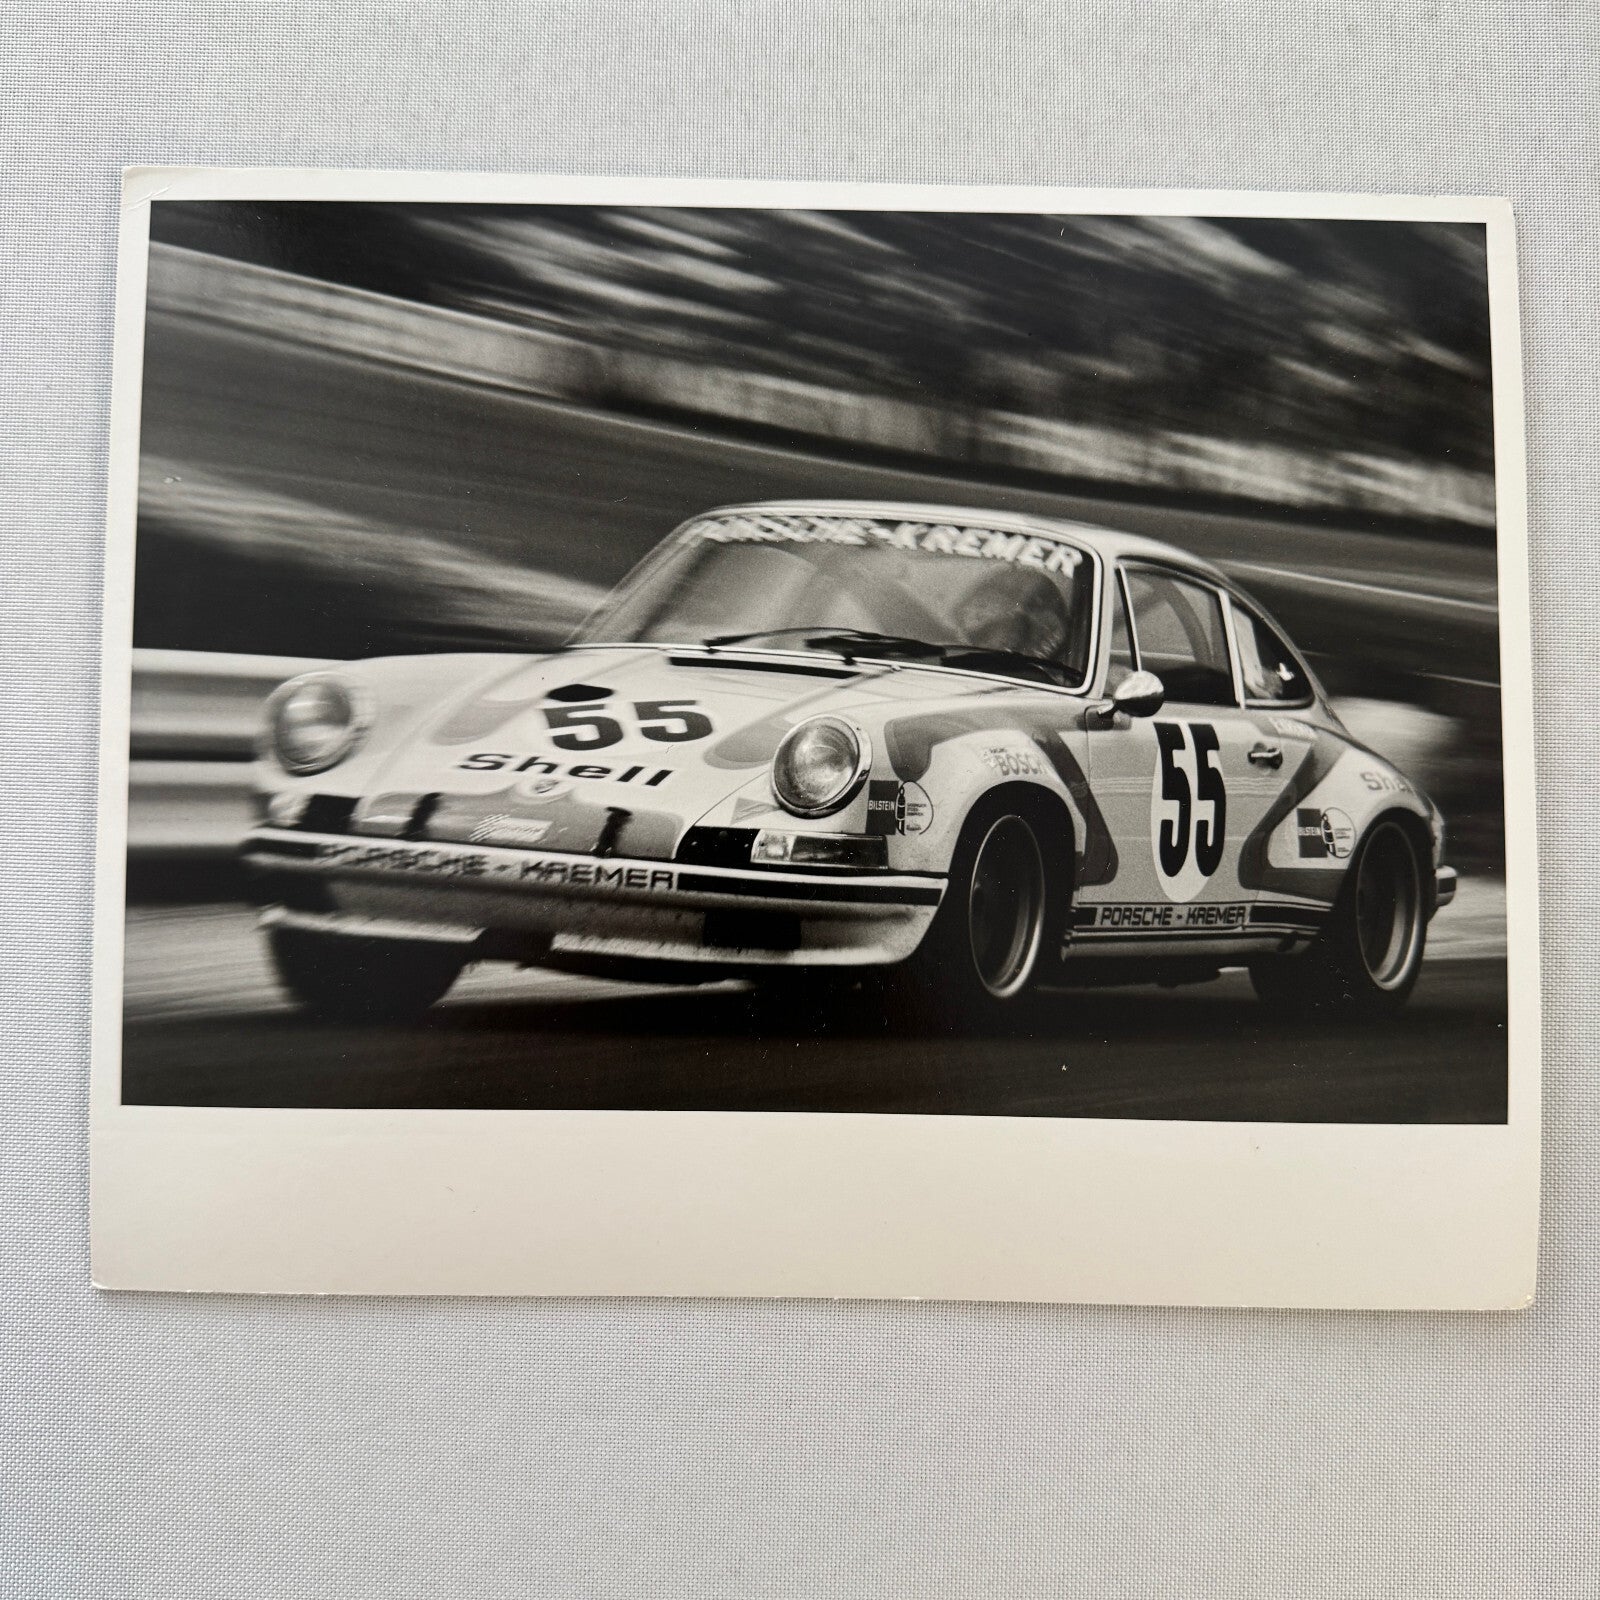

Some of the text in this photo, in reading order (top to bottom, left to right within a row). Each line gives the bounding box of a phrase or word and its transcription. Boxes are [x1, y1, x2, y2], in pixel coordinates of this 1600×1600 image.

[542, 699, 713, 751] 55
[459, 753, 674, 786] Shell
[868, 800, 896, 811] BILSTEIN
[1153, 722, 1227, 877] 55
[519, 859, 674, 890] KREMER
[1100, 906, 1174, 926] PORSCHE
[1186, 905, 1247, 925] KREMER
